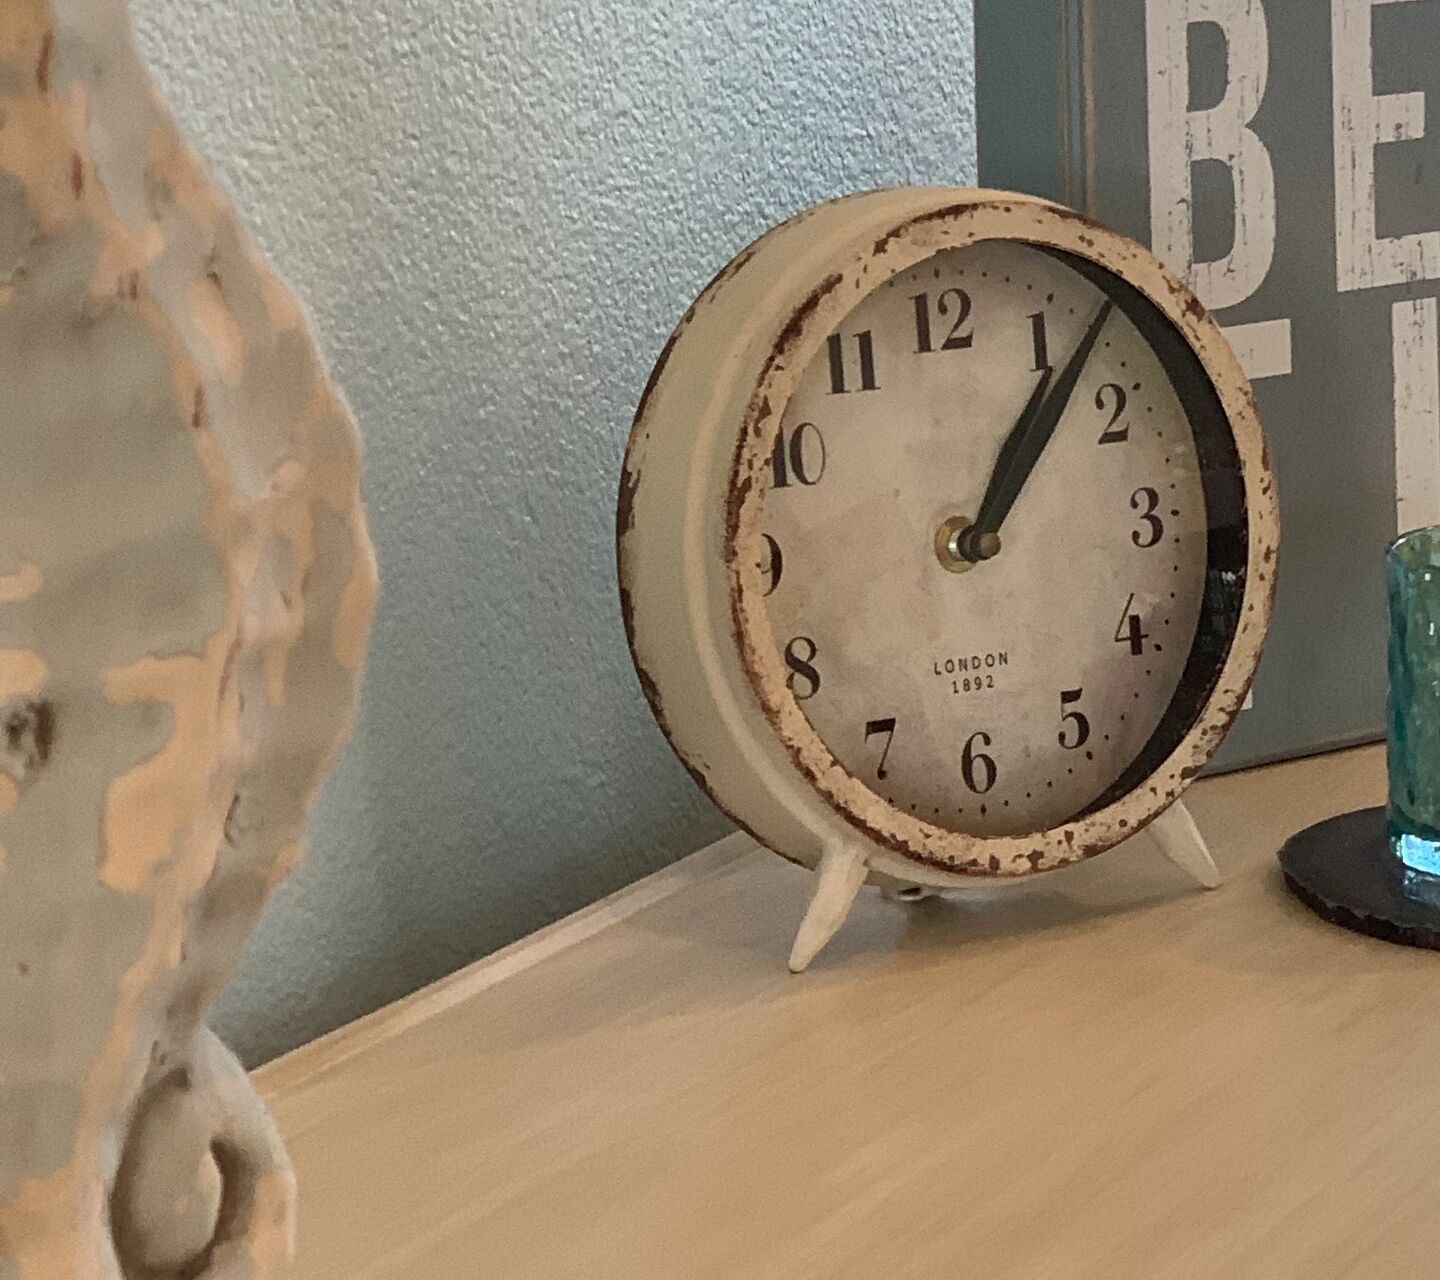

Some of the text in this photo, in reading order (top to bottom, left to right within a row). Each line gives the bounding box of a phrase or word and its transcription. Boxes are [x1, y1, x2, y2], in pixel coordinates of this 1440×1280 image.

[908, 287, 975, 354] 12
[1026, 310, 1051, 372] 1
[826, 329, 882, 395] 11
[1094, 382, 1130, 446] 2
[769, 422, 827, 490] 10
[1130, 486, 1165, 549] 3
[1114, 592, 1150, 657] 4
[784, 636, 822, 701] 8
[933, 651, 1009, 676] LONDON
[951, 674, 995, 695] 1892
[864, 717, 898, 780] 7
[1058, 687, 1091, 750] 5
[960, 731, 998, 794] 6
